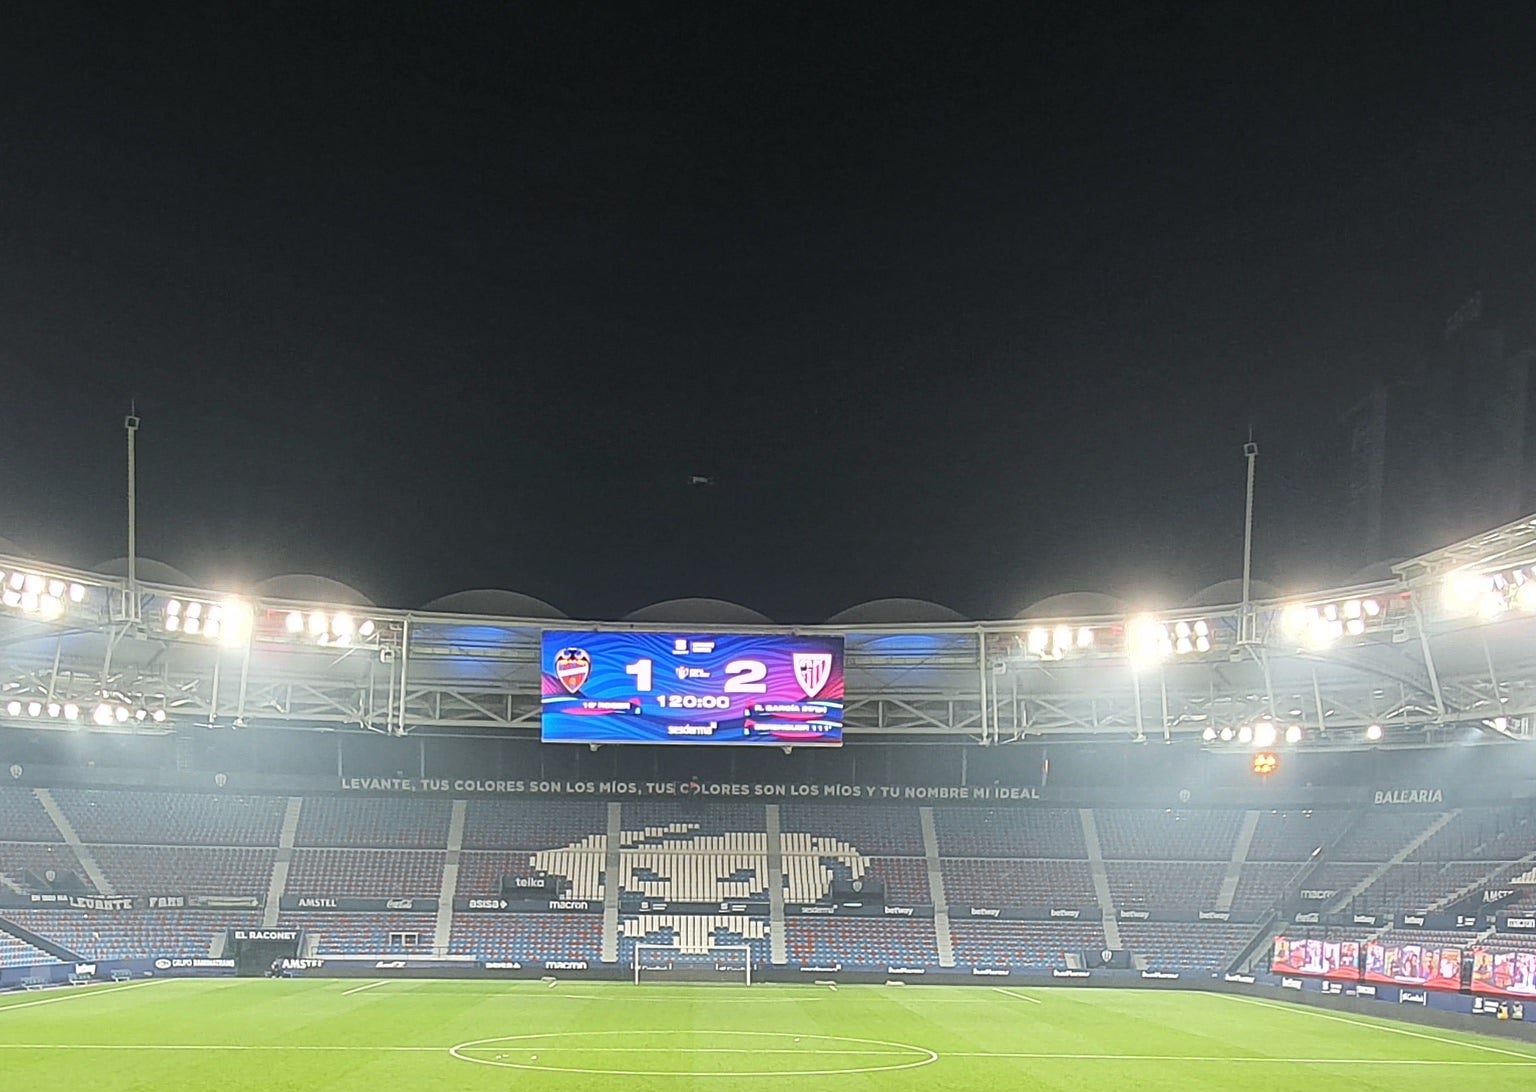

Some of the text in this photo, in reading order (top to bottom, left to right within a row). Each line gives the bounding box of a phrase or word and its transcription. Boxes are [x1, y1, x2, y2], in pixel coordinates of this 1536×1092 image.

[625, 659, 767, 693] 1 2
[656, 695, 730, 709] 120:00
[341, 778, 416, 792] LEVANTE,
[420, 779, 451, 791] TUS
[454, 779, 525, 792] COLORES
[529, 780, 562, 792] SON
[566, 781, 595, 793] LOS
[646, 782, 675, 794] TUS
[680, 781, 750, 796] COLORES
[754, 784, 785, 796] SON
[790, 785, 820, 796] LOS
[824, 784, 862, 797] MÍOS
[865, 786, 876, 797] Y
[880, 787, 901, 798] TU
[904, 786, 970, 799] NOMBRE
[973, 788, 991, 799] MI
[994, 787, 1040, 800] IDEAL
[298, 898, 337, 908] AMSTEL
[549, 901, 588, 910] macron
[235, 931, 296, 941] EL RACONET
